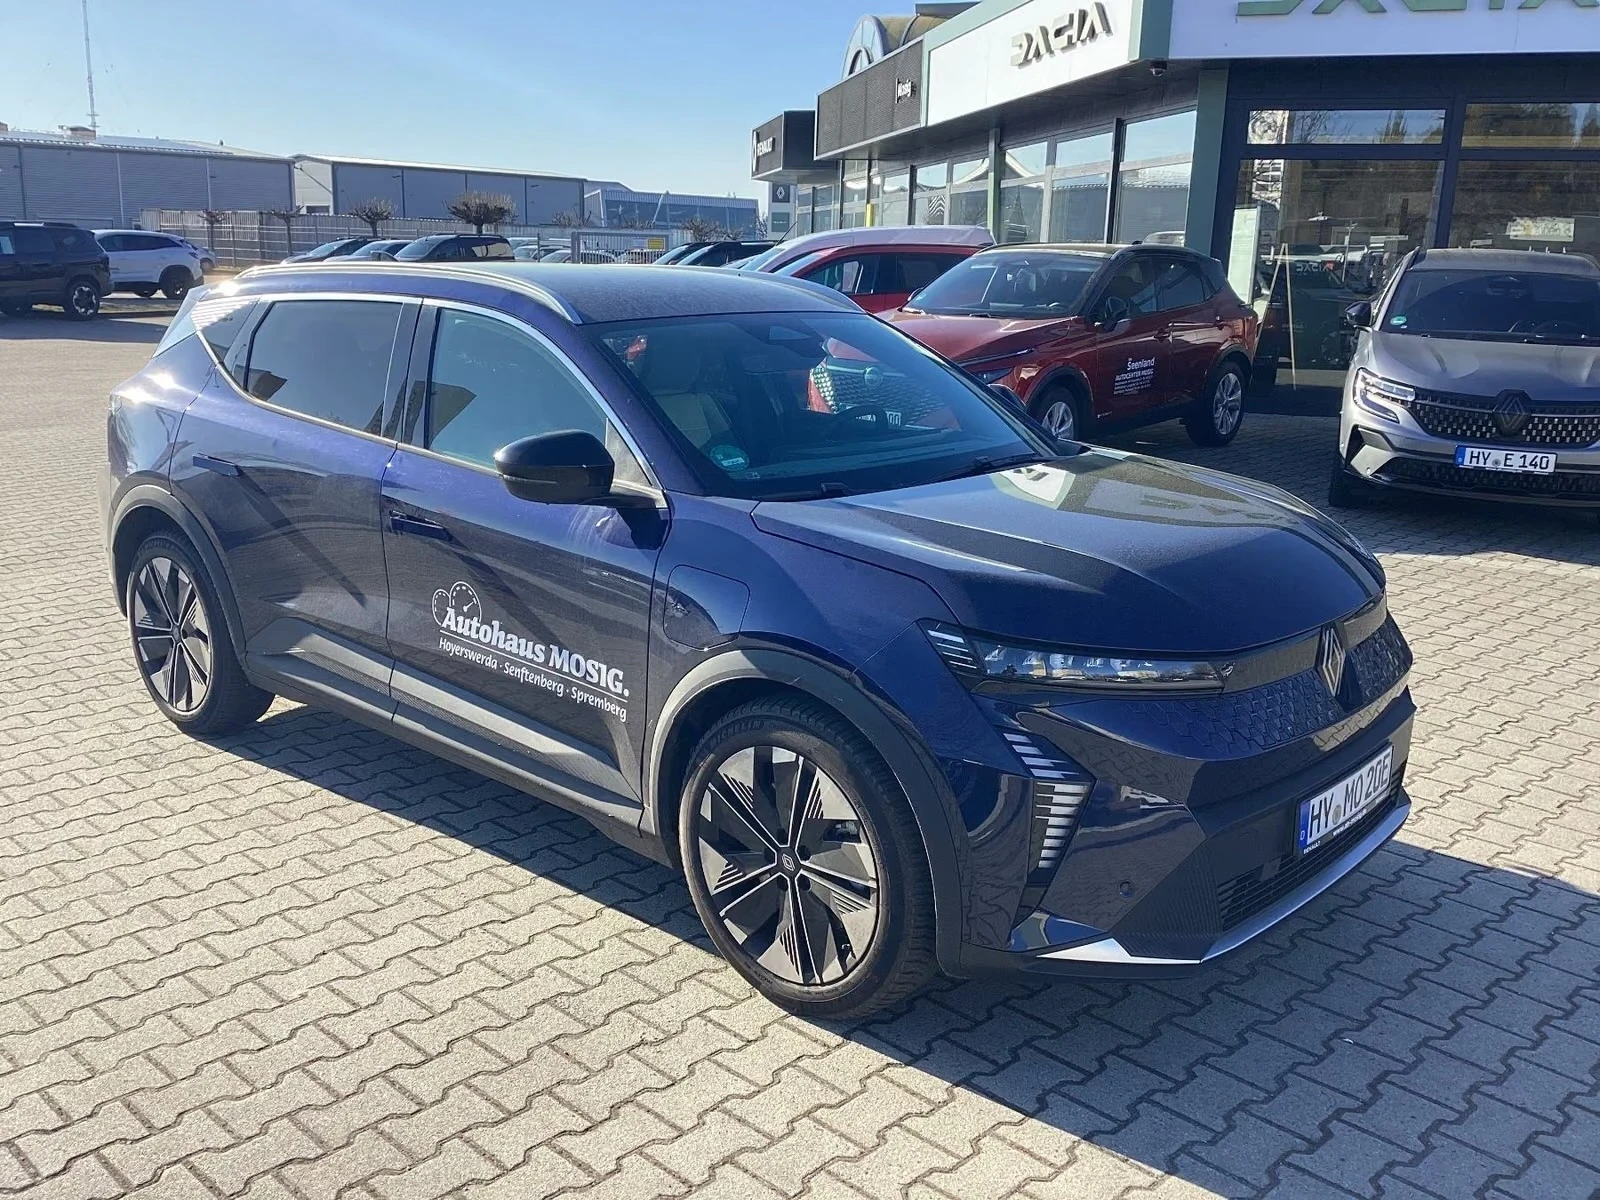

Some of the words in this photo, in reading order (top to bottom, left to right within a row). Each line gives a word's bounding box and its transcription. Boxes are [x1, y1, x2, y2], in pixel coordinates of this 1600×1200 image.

[1010, 1, 1113, 69] DACIA
[1127, 357, 1155, 371] Seenland
[1469, 450, 1492, 466] HY
[1503, 452, 1515, 468] E
[1518, 453, 1550, 470] 140
[439, 637, 498, 670] Hoyerswerda
[503, 662, 564, 697] Senftenberg
[571, 686, 627, 722] Spremberg
[441, 607, 546, 663] Autohaus
[549, 645, 630, 697] MOSIG.
[1308, 792, 1335, 839] HY
[1343, 774, 1364, 818] MO
